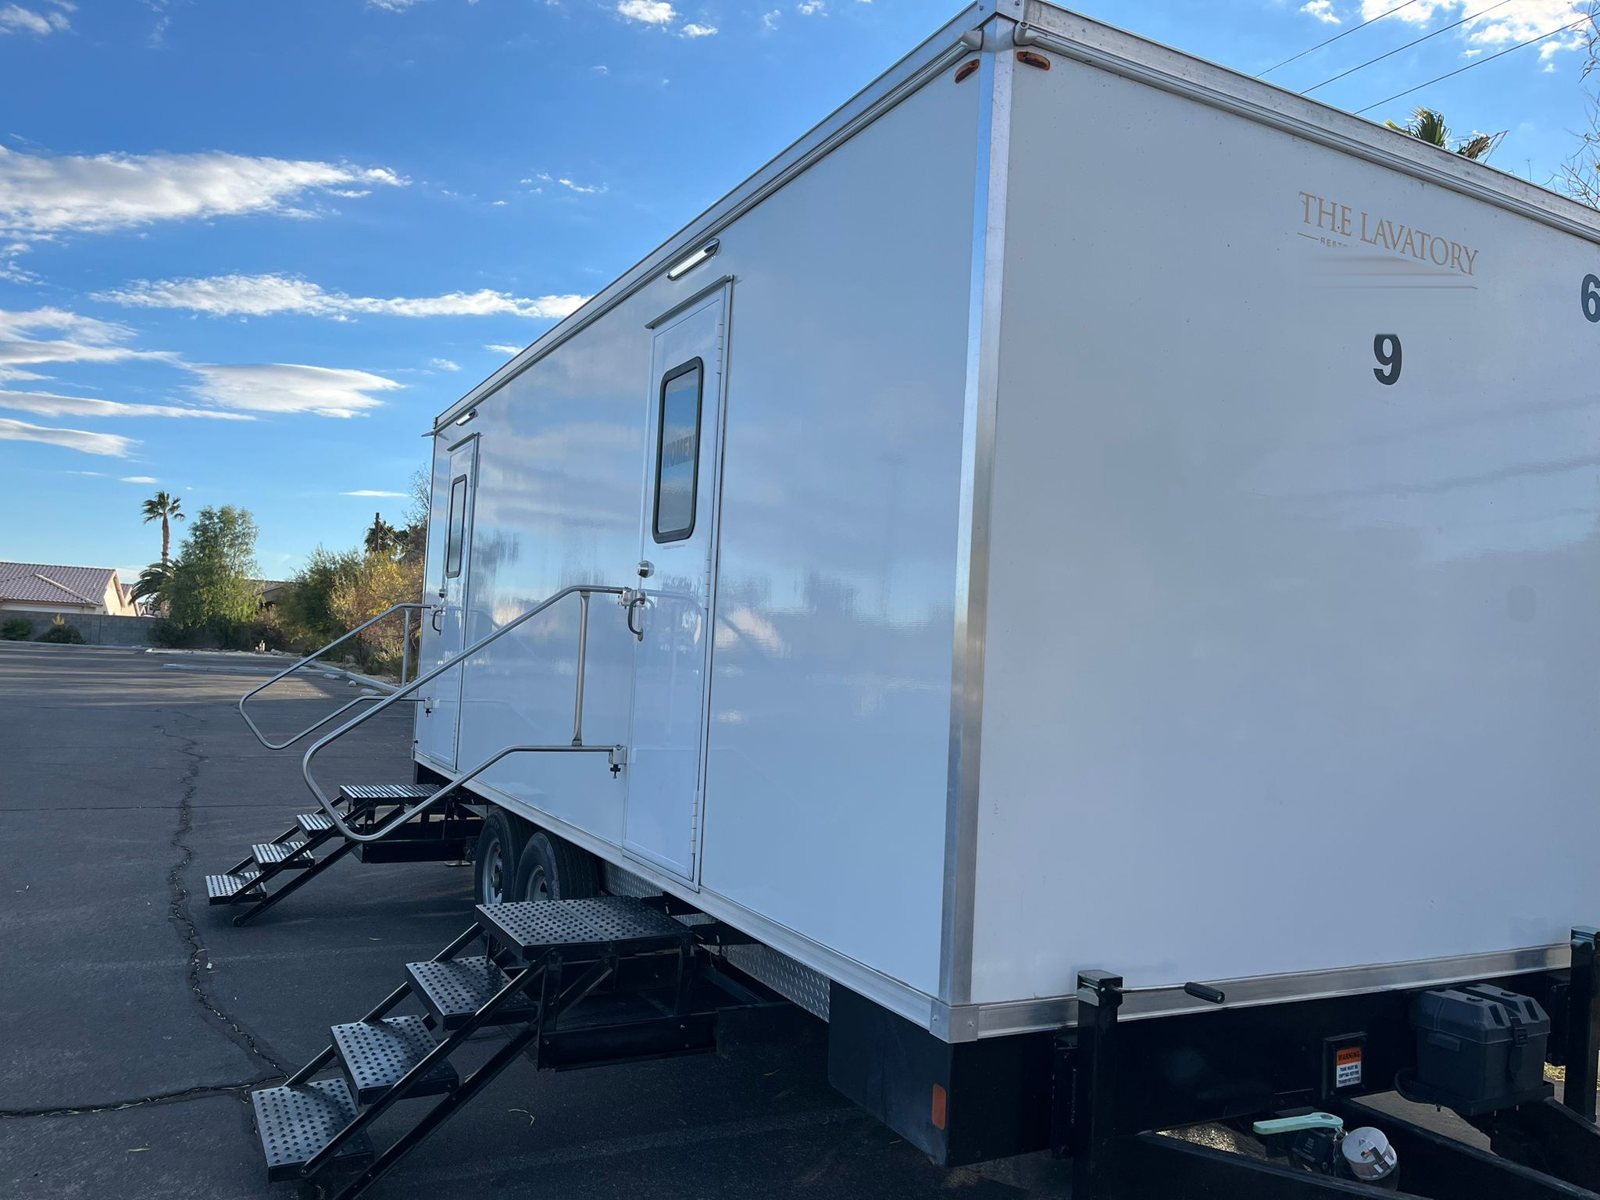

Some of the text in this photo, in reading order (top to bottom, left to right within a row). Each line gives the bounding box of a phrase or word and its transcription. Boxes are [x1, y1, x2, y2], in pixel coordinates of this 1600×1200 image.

[1299, 191, 1479, 276] THE LAVATORY
[1581, 273, 1600, 323] 6
[1373, 333, 1402, 385] 9
